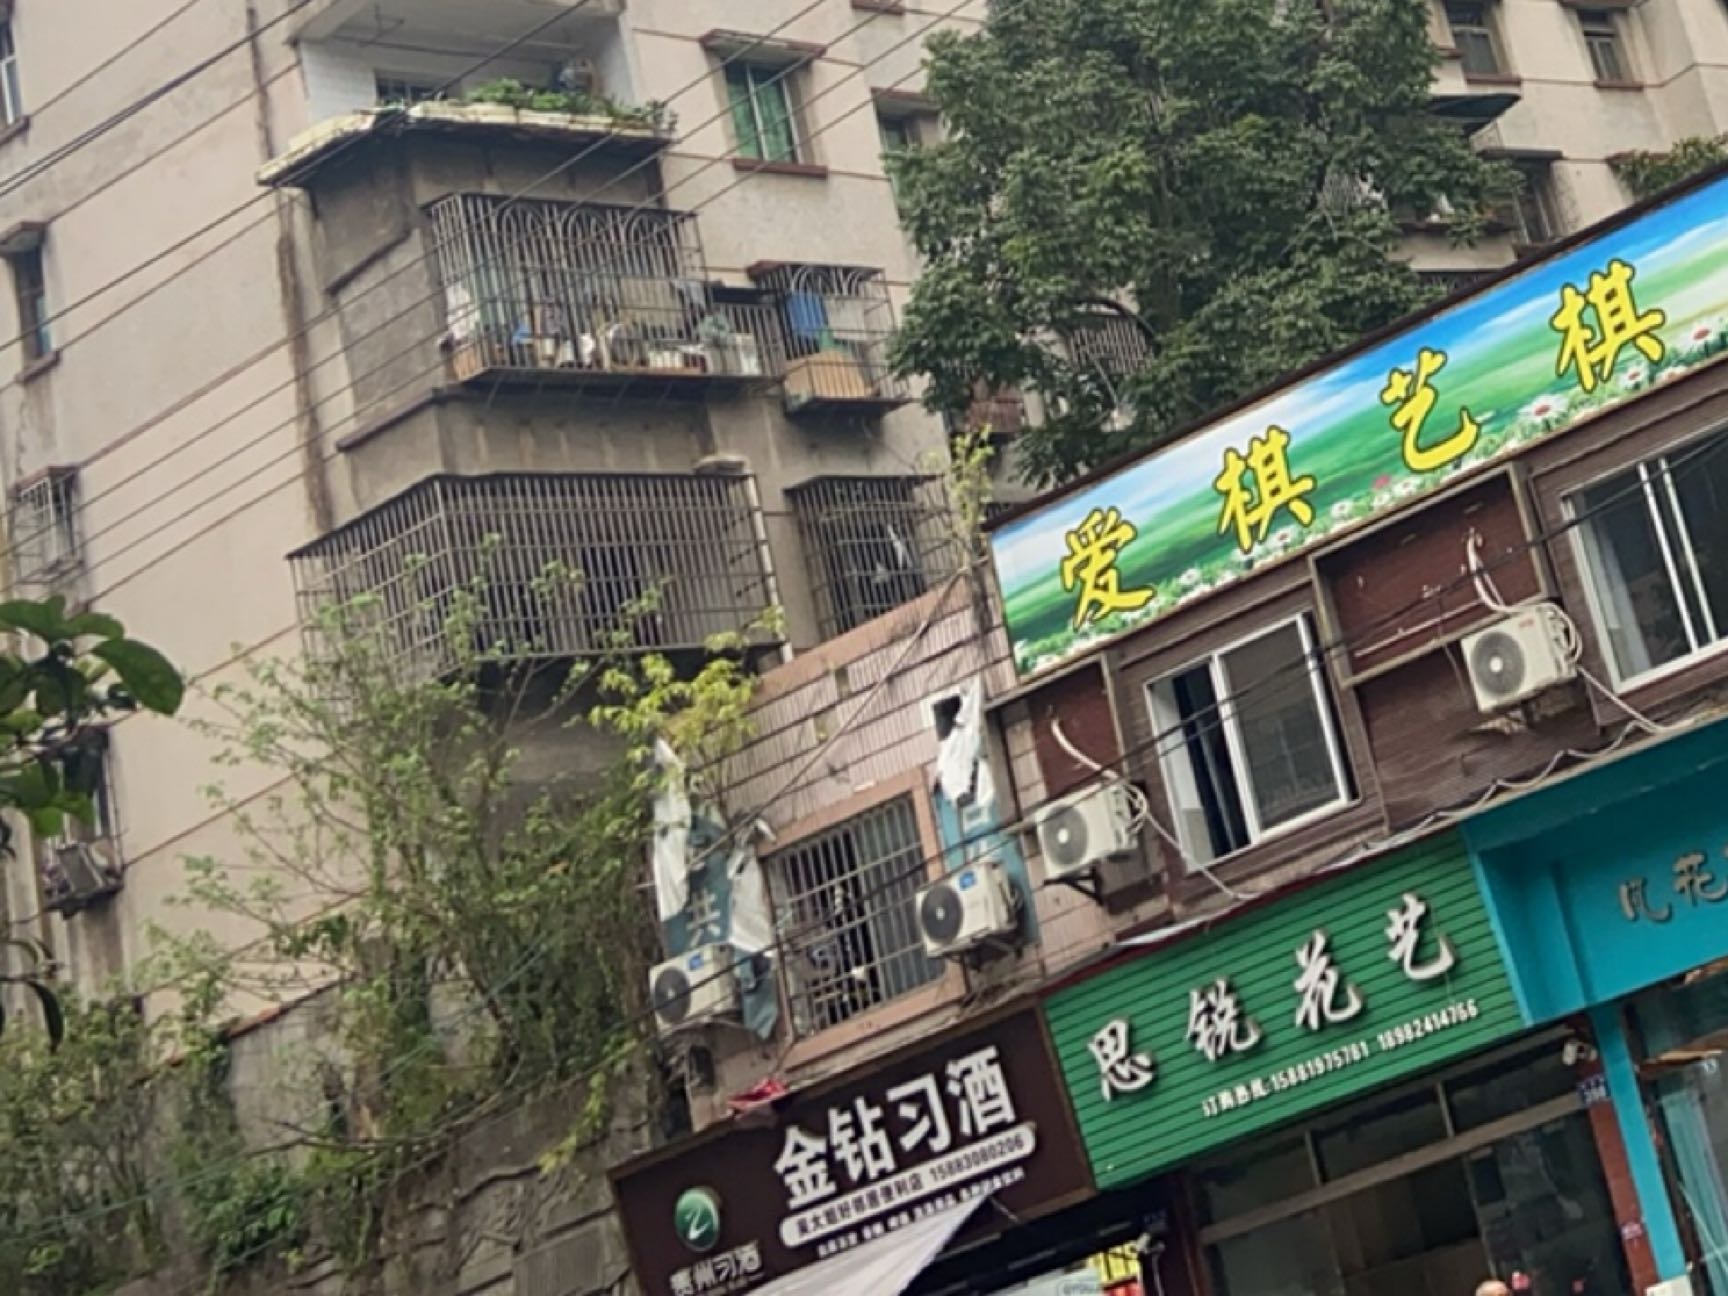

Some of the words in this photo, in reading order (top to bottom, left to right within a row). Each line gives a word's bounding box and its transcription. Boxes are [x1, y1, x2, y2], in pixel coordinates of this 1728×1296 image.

[1086, 891, 1457, 1103] 思锐花艺
[773, 1045, 1016, 1209] 金钻习酒
